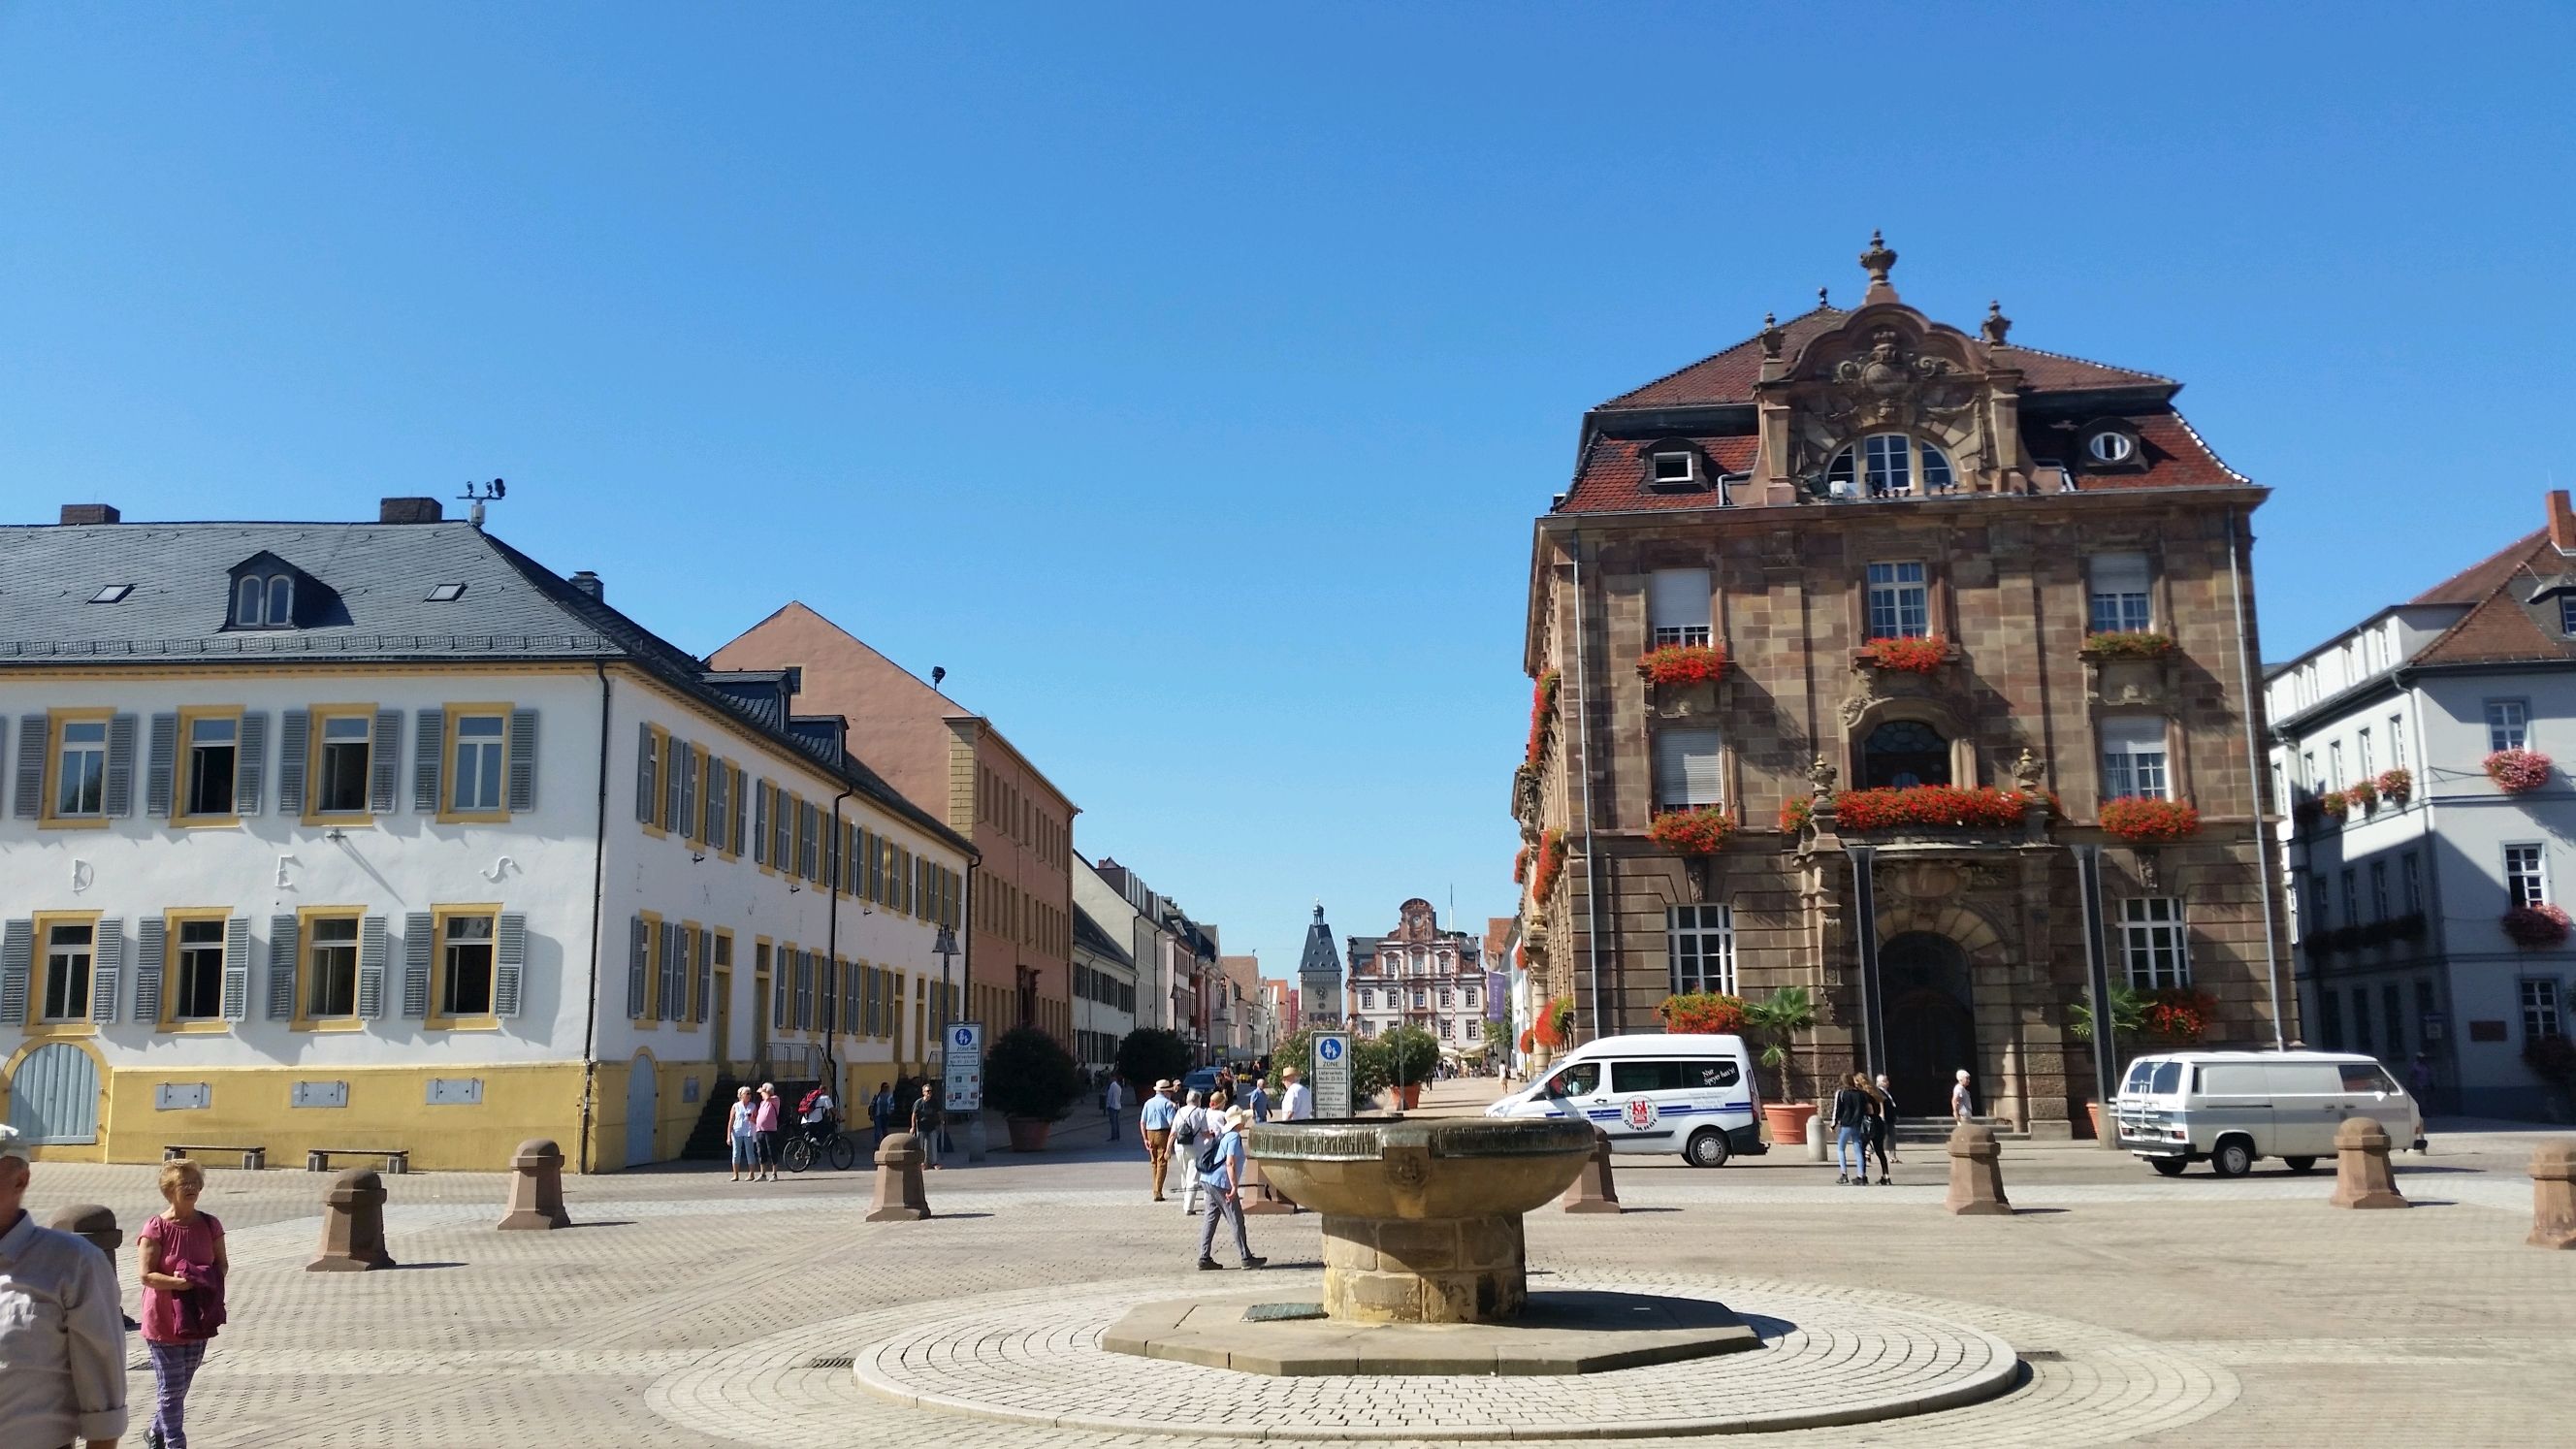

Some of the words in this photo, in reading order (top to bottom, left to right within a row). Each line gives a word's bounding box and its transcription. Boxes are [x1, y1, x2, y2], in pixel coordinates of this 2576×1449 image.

[73, 858, 94, 892] D
[276, 854, 295, 889] E
[480, 855, 516, 884] S
[1701, 1069, 1715, 1078] Nur
[1703, 1074, 1721, 1085] Speyer
